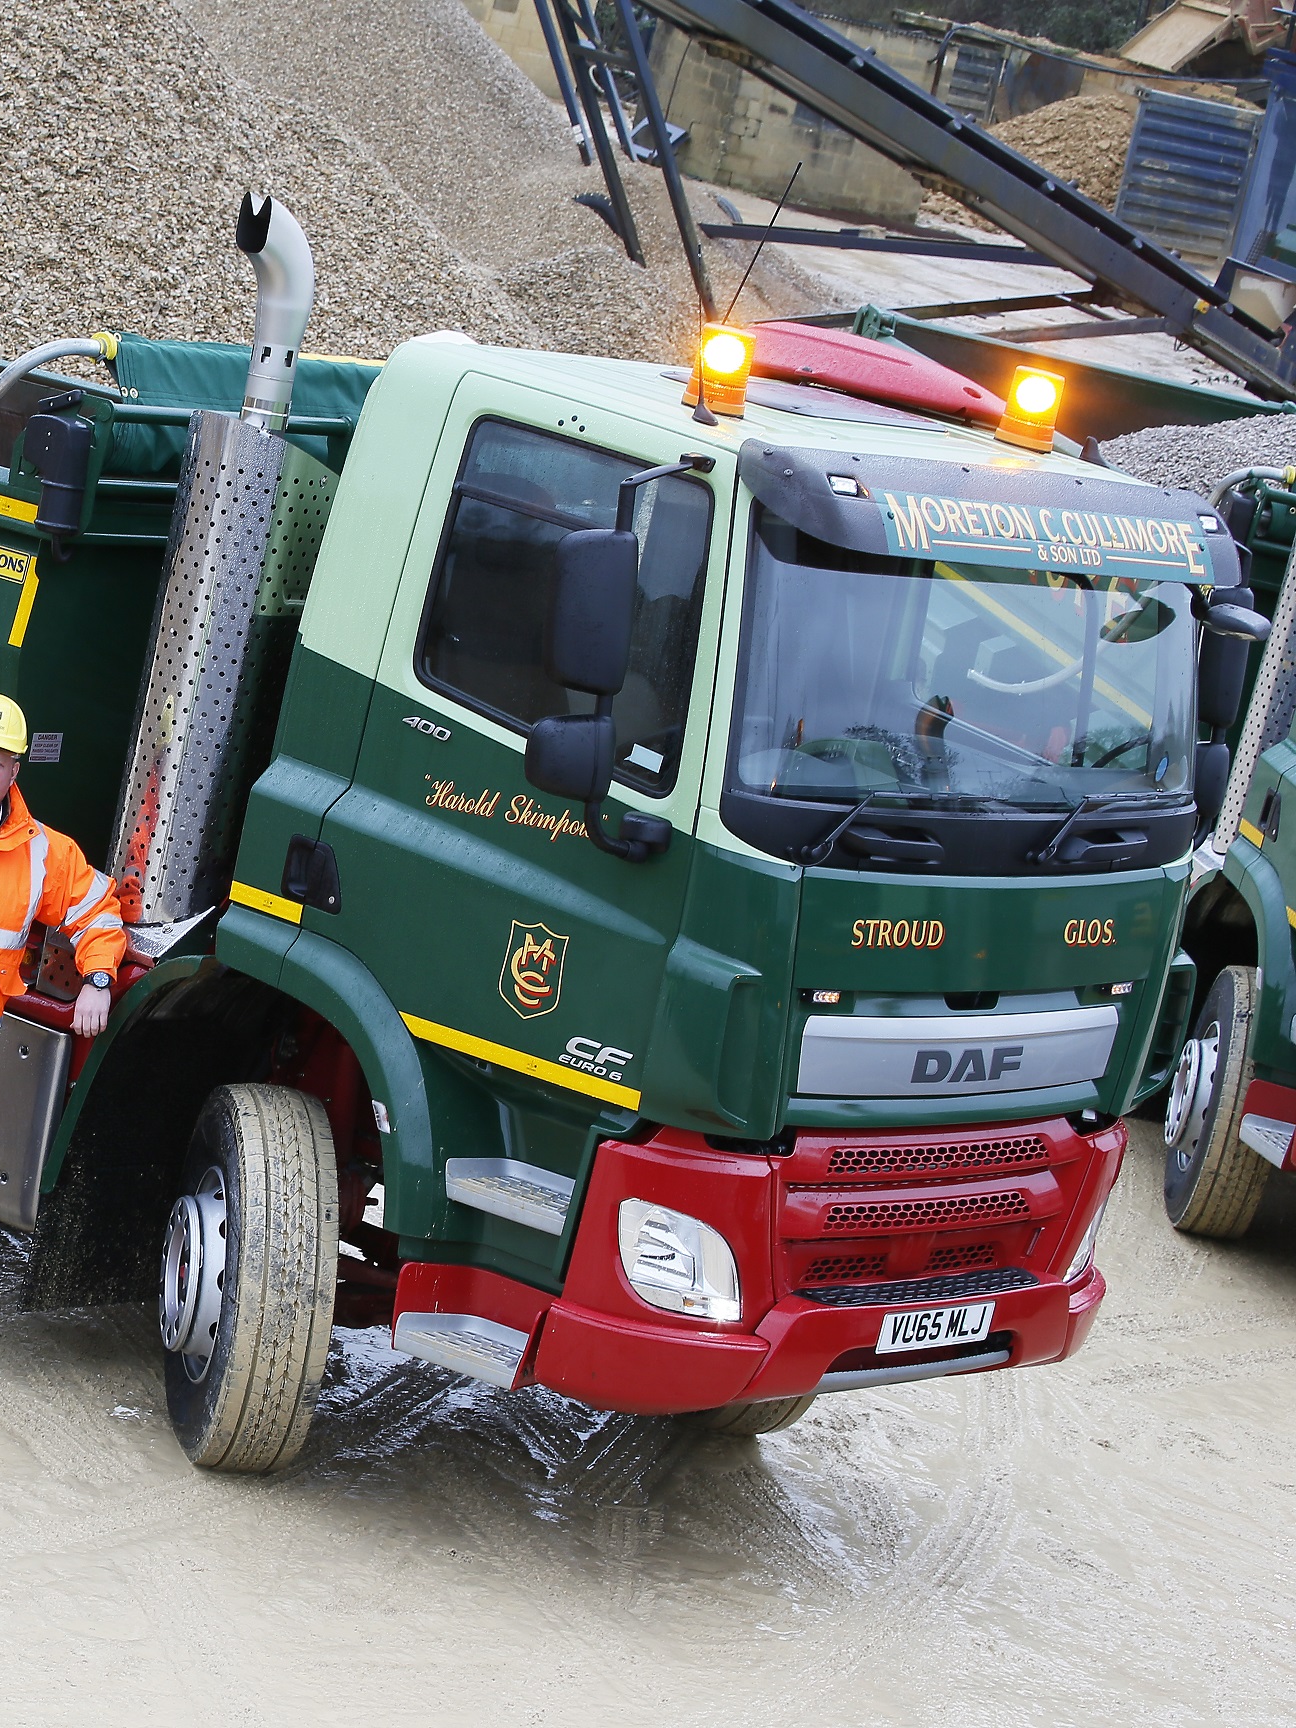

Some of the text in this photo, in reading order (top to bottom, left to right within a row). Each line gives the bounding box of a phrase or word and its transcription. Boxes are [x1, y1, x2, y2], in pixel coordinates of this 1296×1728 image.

[883, 493, 1037, 551] MORETON
[1037, 544, 1102, 567] & SON LTD
[402, 715, 452, 742] 400
[851, 918, 1117, 950] STROUD GLOS.
[565, 1036, 634, 1066] CF
[910, 1046, 1024, 1084] DAF
[558, 1053, 608, 1076] EURO
[608, 1071, 623, 1082] 6
[891, 1306, 987, 1345] VU65 MLJ
